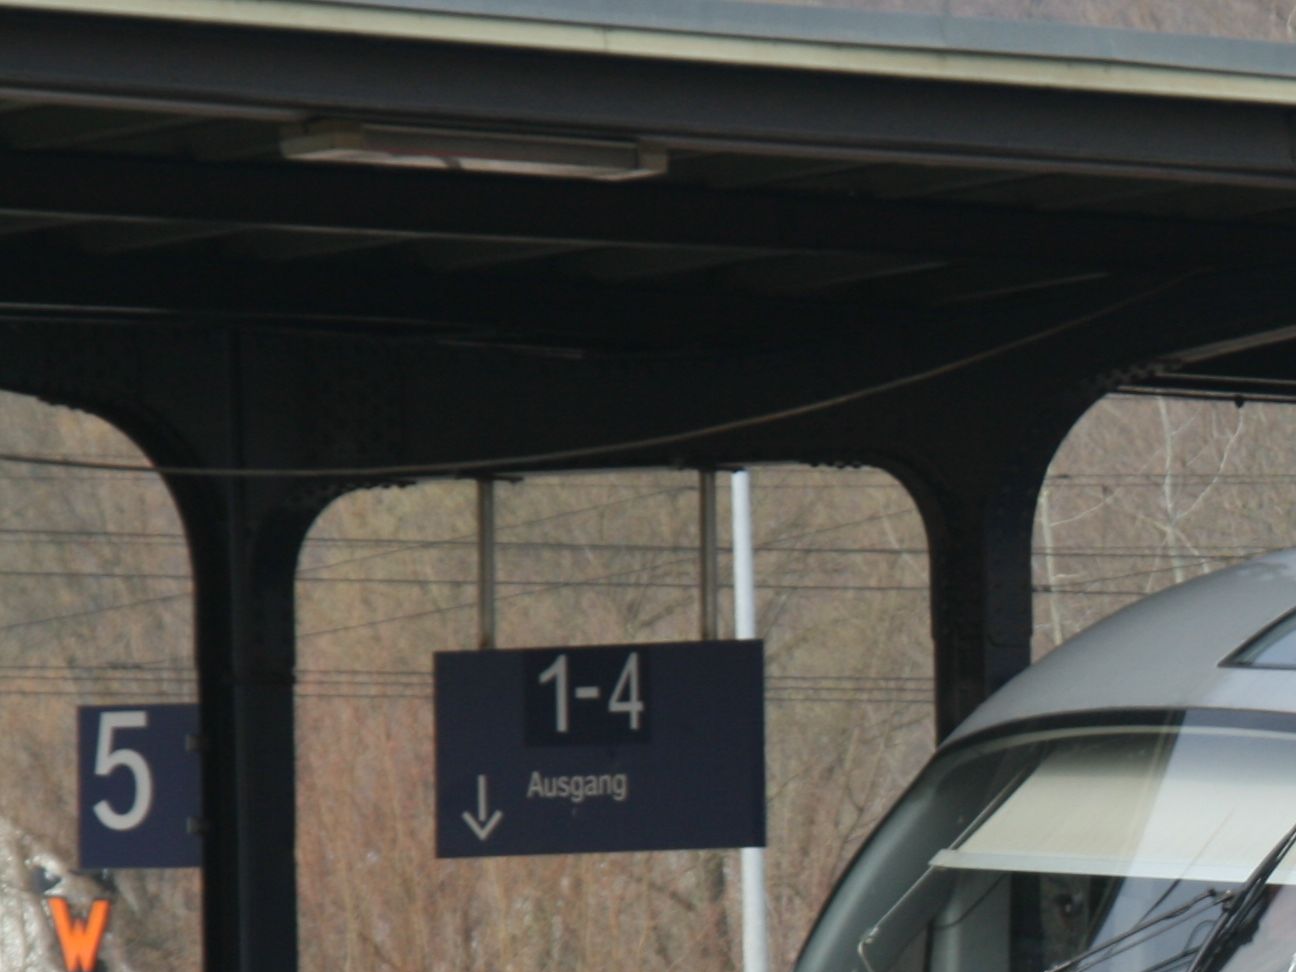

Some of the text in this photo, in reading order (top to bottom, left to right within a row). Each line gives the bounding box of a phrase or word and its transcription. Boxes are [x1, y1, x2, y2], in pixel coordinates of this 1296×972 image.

[538, 652, 645, 733] 1-4
[92, 710, 154, 832] 5
[526, 770, 628, 804] Ausgang
